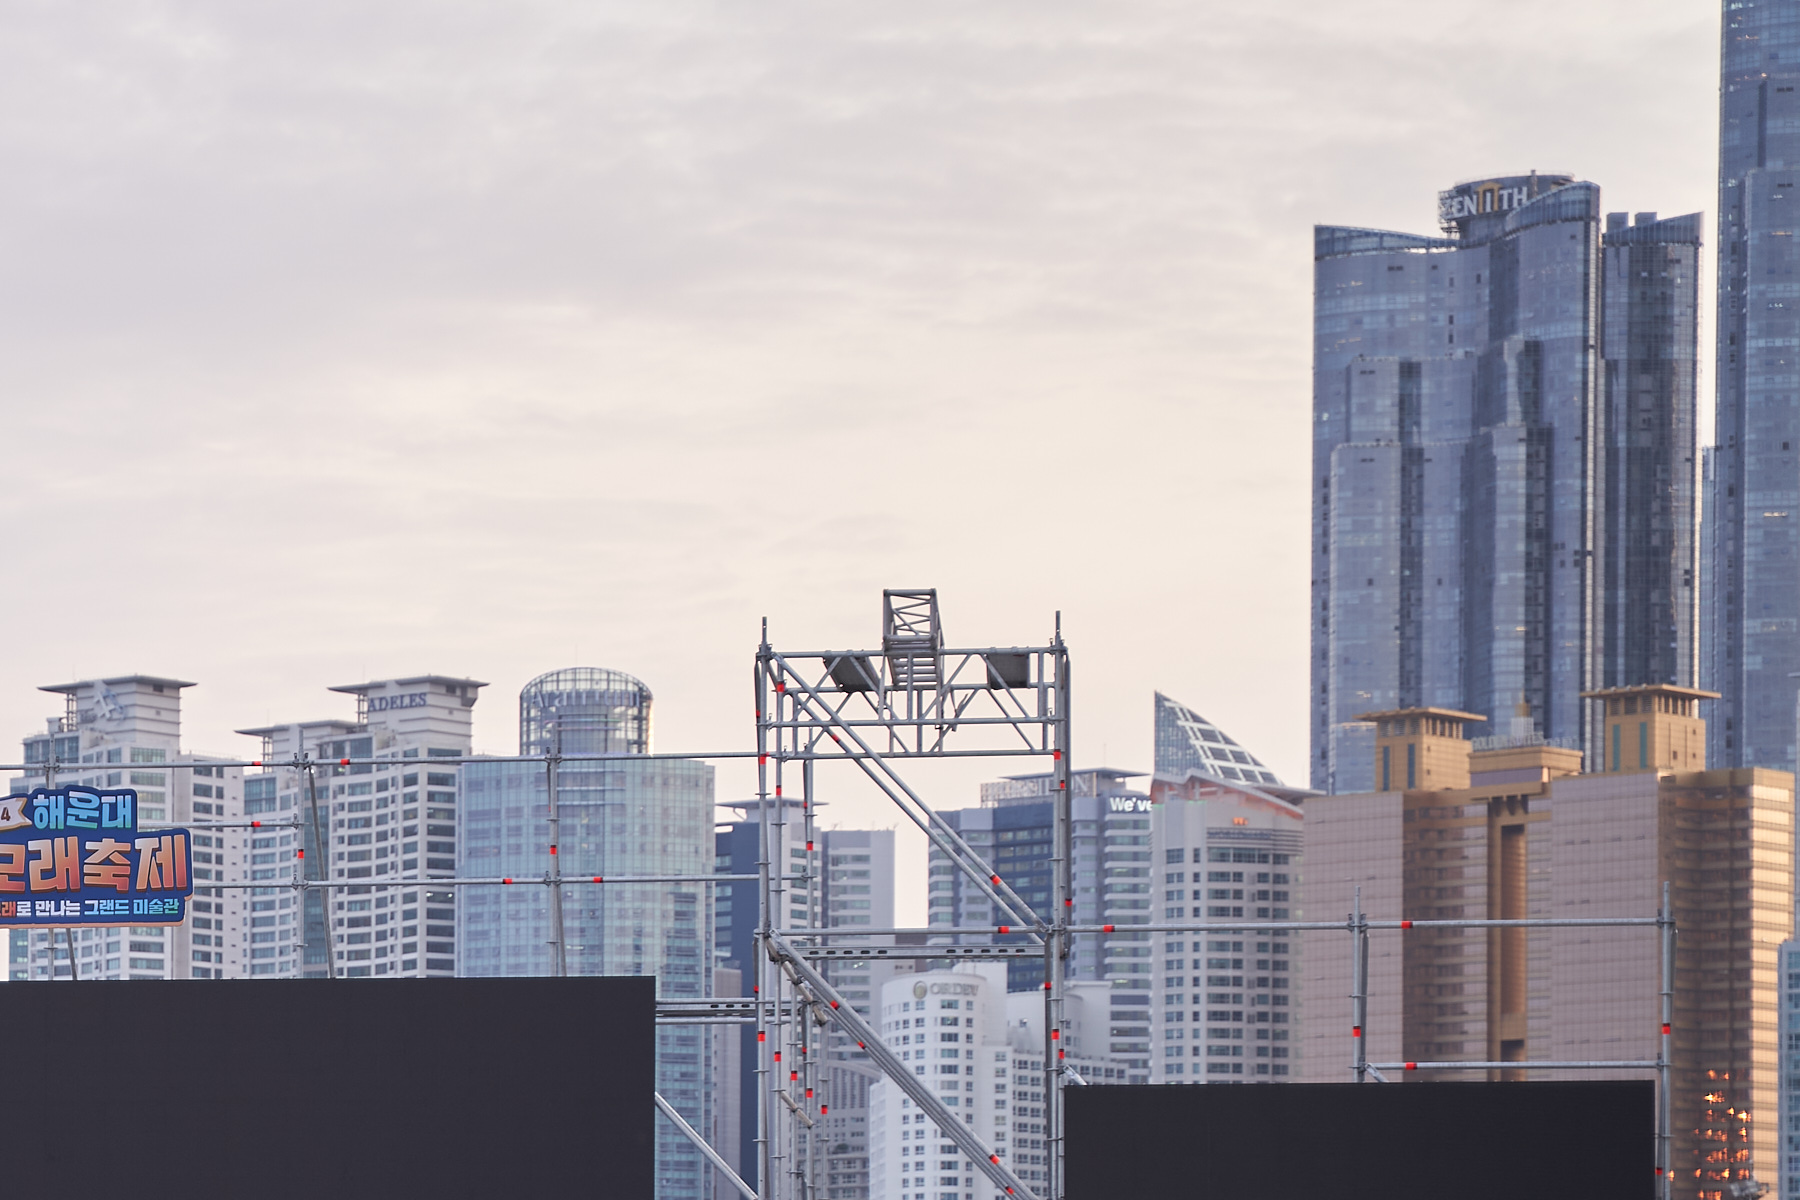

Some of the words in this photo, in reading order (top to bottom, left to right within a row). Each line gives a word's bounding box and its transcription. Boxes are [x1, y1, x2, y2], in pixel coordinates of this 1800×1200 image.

[1440, 186, 1528, 219] ZENITH
[32, 790, 132, 830] 해운대
[35, 899, 81, 917] 만나는
[84, 899, 130, 916] 그랜드
[133, 898, 179, 915] 미술관
